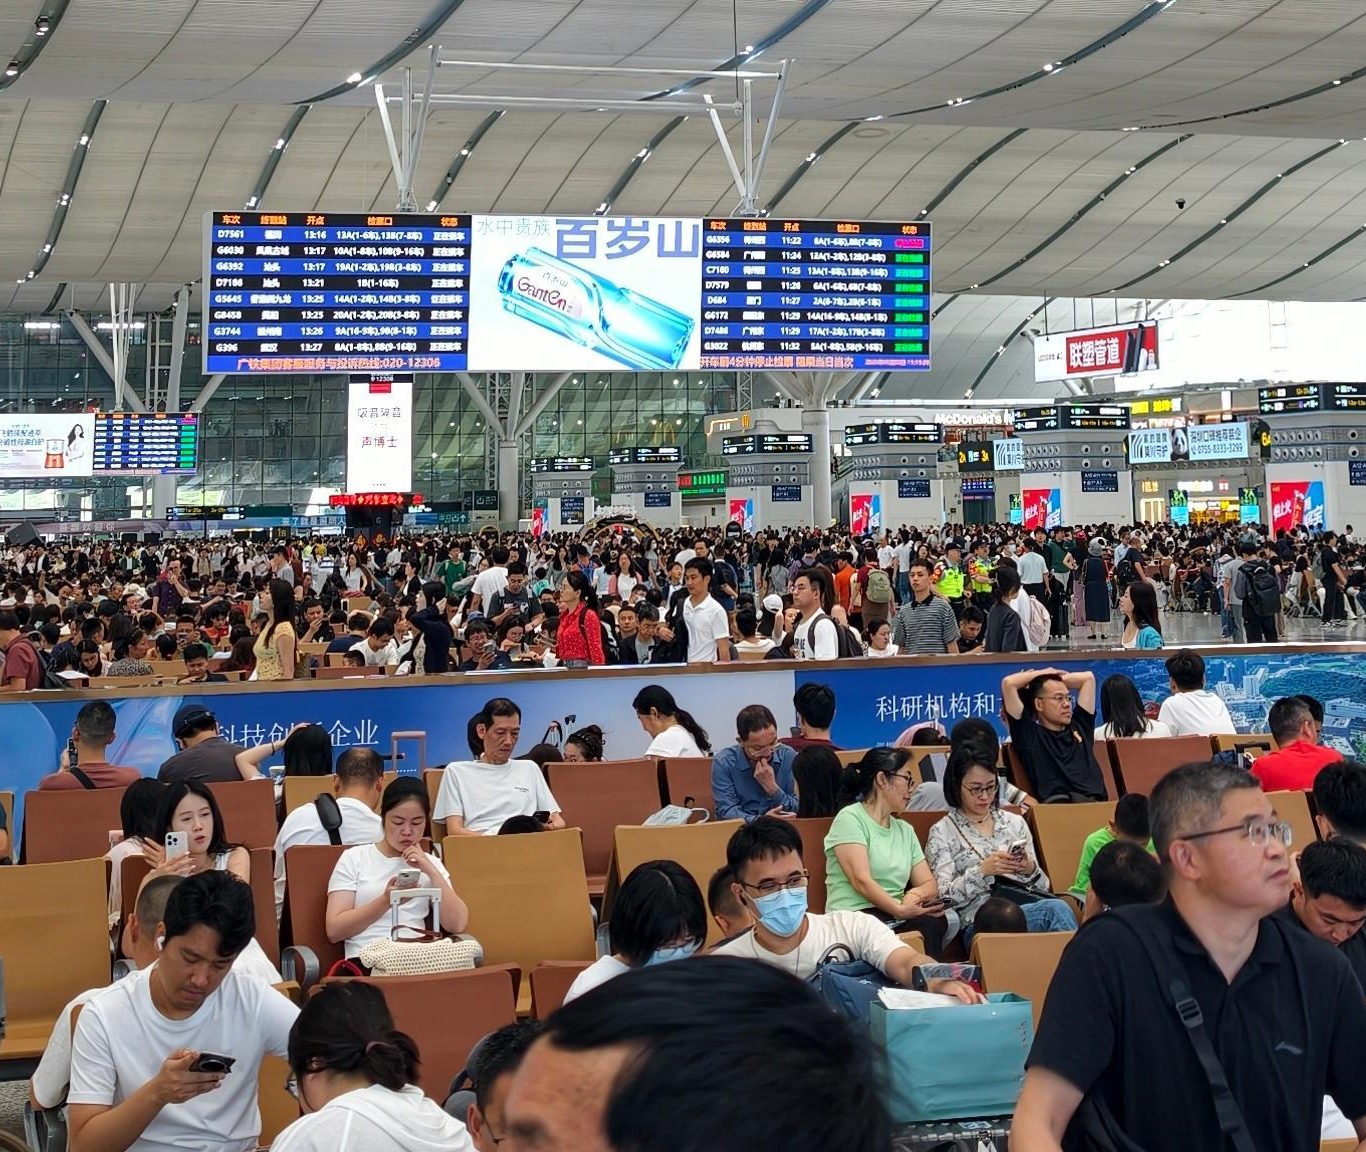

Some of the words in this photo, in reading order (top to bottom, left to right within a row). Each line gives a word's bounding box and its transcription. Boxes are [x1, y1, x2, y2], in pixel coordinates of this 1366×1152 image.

[477, 218, 552, 237] 水中贵族
[556, 218, 699, 259] 百岁山
[1069, 337, 1121, 368] 联塑管道
[876, 692, 1003, 723] 科研机构和
